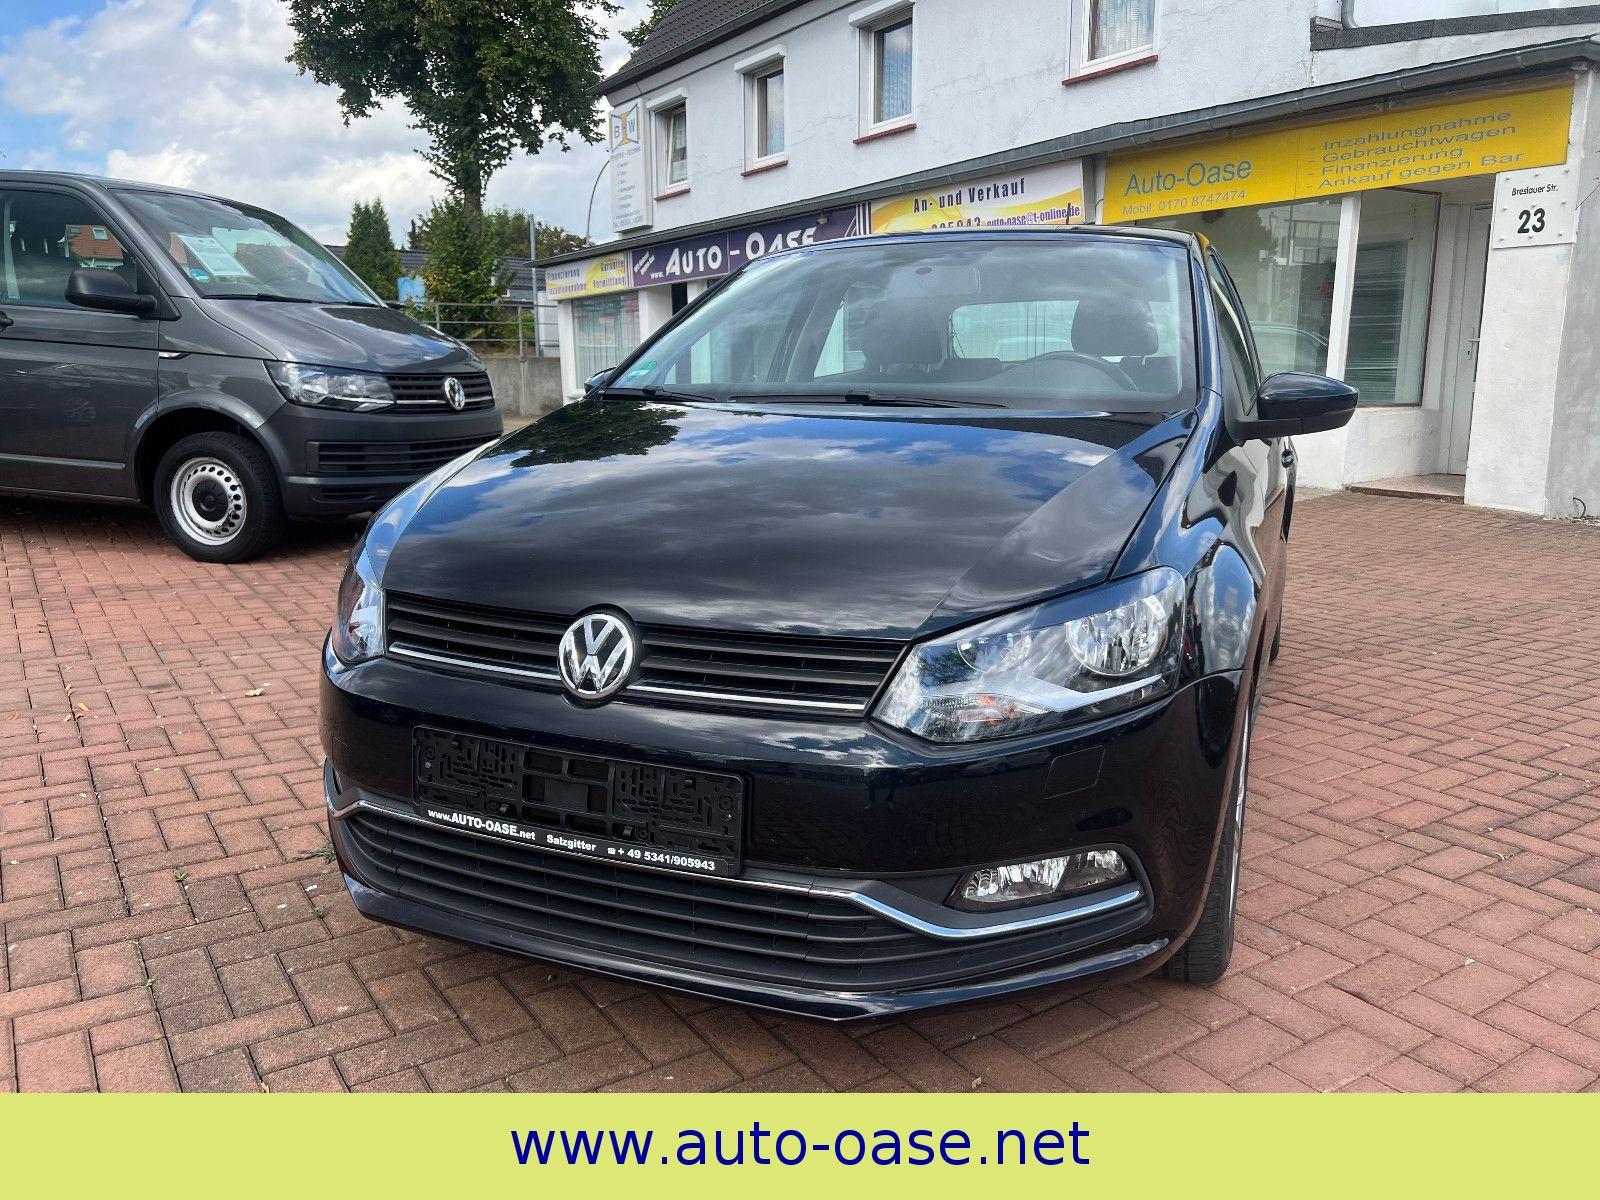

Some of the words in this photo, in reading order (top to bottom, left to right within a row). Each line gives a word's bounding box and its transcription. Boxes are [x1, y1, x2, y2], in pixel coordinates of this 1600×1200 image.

[1322, 126, 1517, 163] Gebrauchtwagen
[1323, 112, 1513, 151] Inzahlungnahme
[1124, 160, 1252, 197] Auto-Oase
[1319, 170, 1393, 189] Ankauf
[1399, 160, 1471, 178] gegen
[1481, 151, 1525, 167] Bar
[1321, 148, 1464, 176] Finanzierung
[939, 190, 962, 208] und
[968, 178, 1025, 203] Verkauf
[1158, 197, 1188, 211] 0170
[1191, 189, 1246, 207] 8747474
[1511, 185, 1545, 196] Breslauer
[1546, 183, 1559, 193] Str.
[1517, 207, 1546, 234] 23
[427, 809, 536, 841] www.AUTO-OASE.net
[546, 834, 597, 852] Salzgitter
[627, 848, 642, 860] 49
[643, 851, 716, 871] 5341/905943
